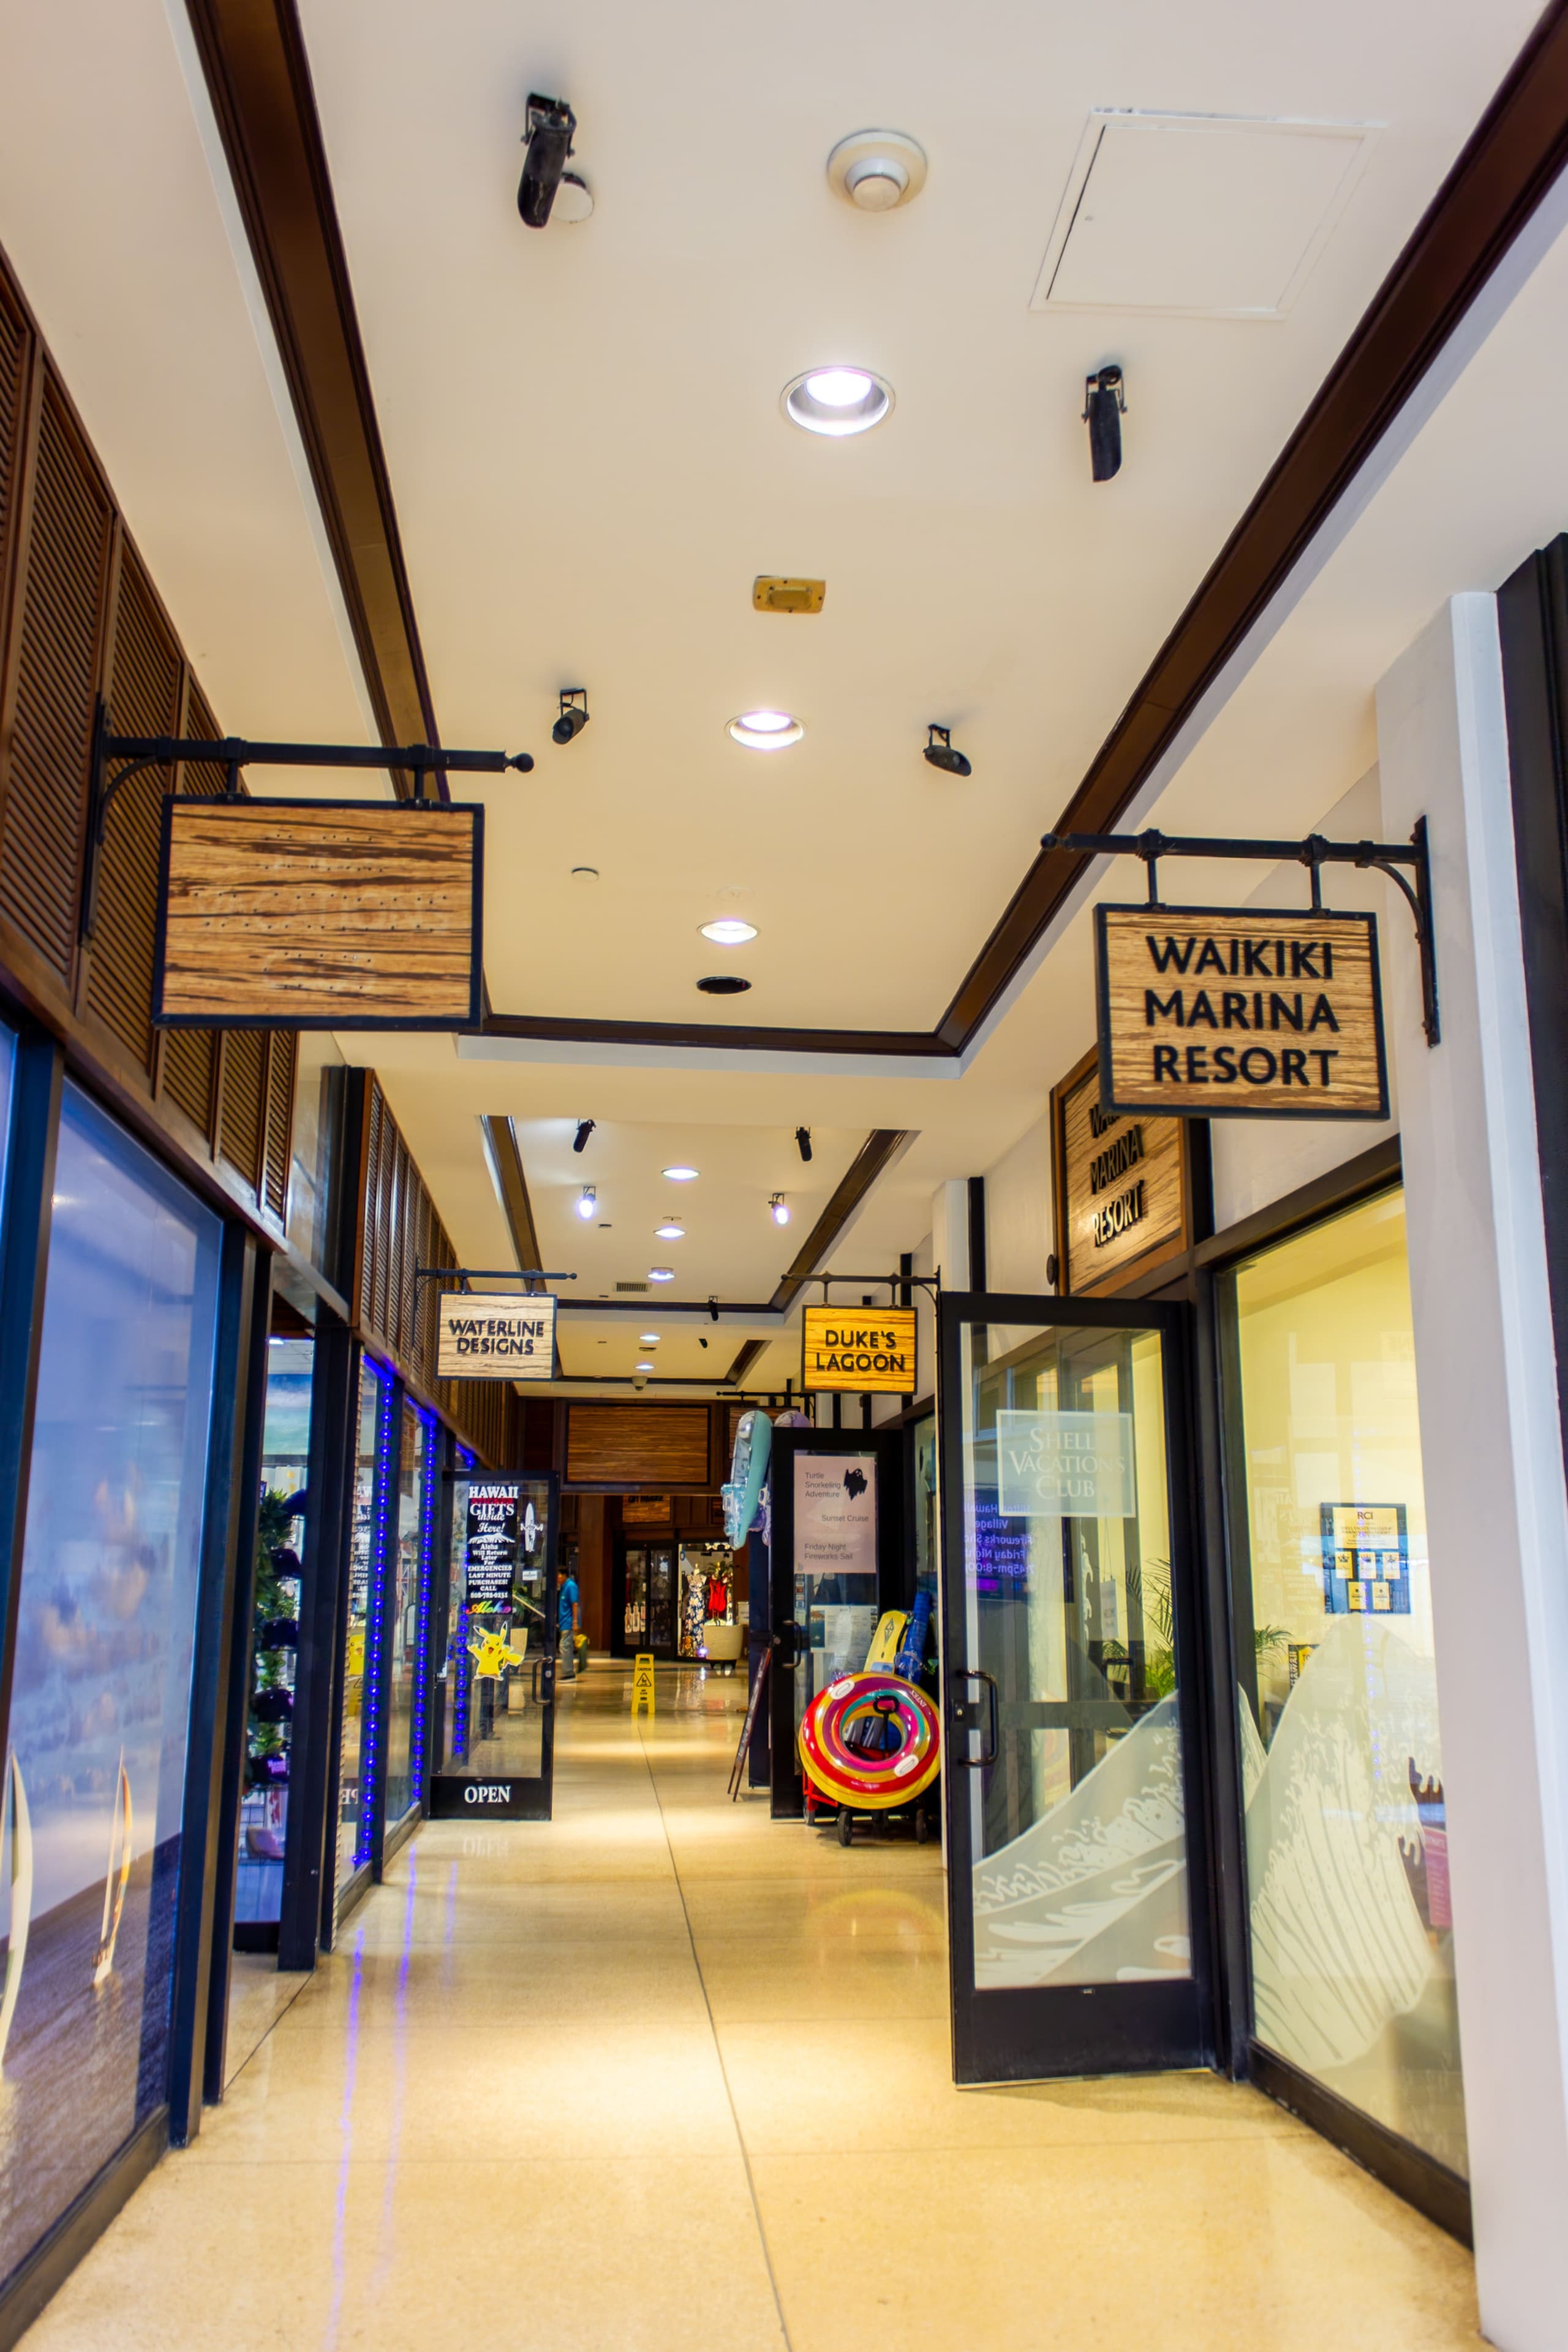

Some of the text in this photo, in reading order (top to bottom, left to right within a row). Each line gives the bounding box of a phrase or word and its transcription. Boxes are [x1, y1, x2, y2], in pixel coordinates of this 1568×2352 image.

[1145, 936, 1333, 980] WAIKIKI
[1145, 989, 1340, 1032] MARINA
[1153, 1045, 1339, 1086] RESORT
[1090, 1124, 1144, 1195] MARINA
[1093, 1179, 1145, 1247] RESORT
[448, 1319, 545, 1337] WATERLINE
[457, 1337, 534, 1355] DESIGNS
[826, 1329, 896, 1349] DUKE'S
[816, 1352, 905, 1372] LAGOON
[1030, 1427, 1096, 1452] SHELL
[1009, 1451, 1125, 1476] VACATIONS
[469, 1486, 519, 1499] HAWAII
[1036, 1475, 1095, 1499] CLUB
[470, 1503, 514, 1516] GIFTS
[477, 1522, 505, 1532] Here!
[828, 1543, 846, 1552] Night
[466, 1600, 511, 1614] Aloha
[464, 1785, 511, 1803] OPEN
